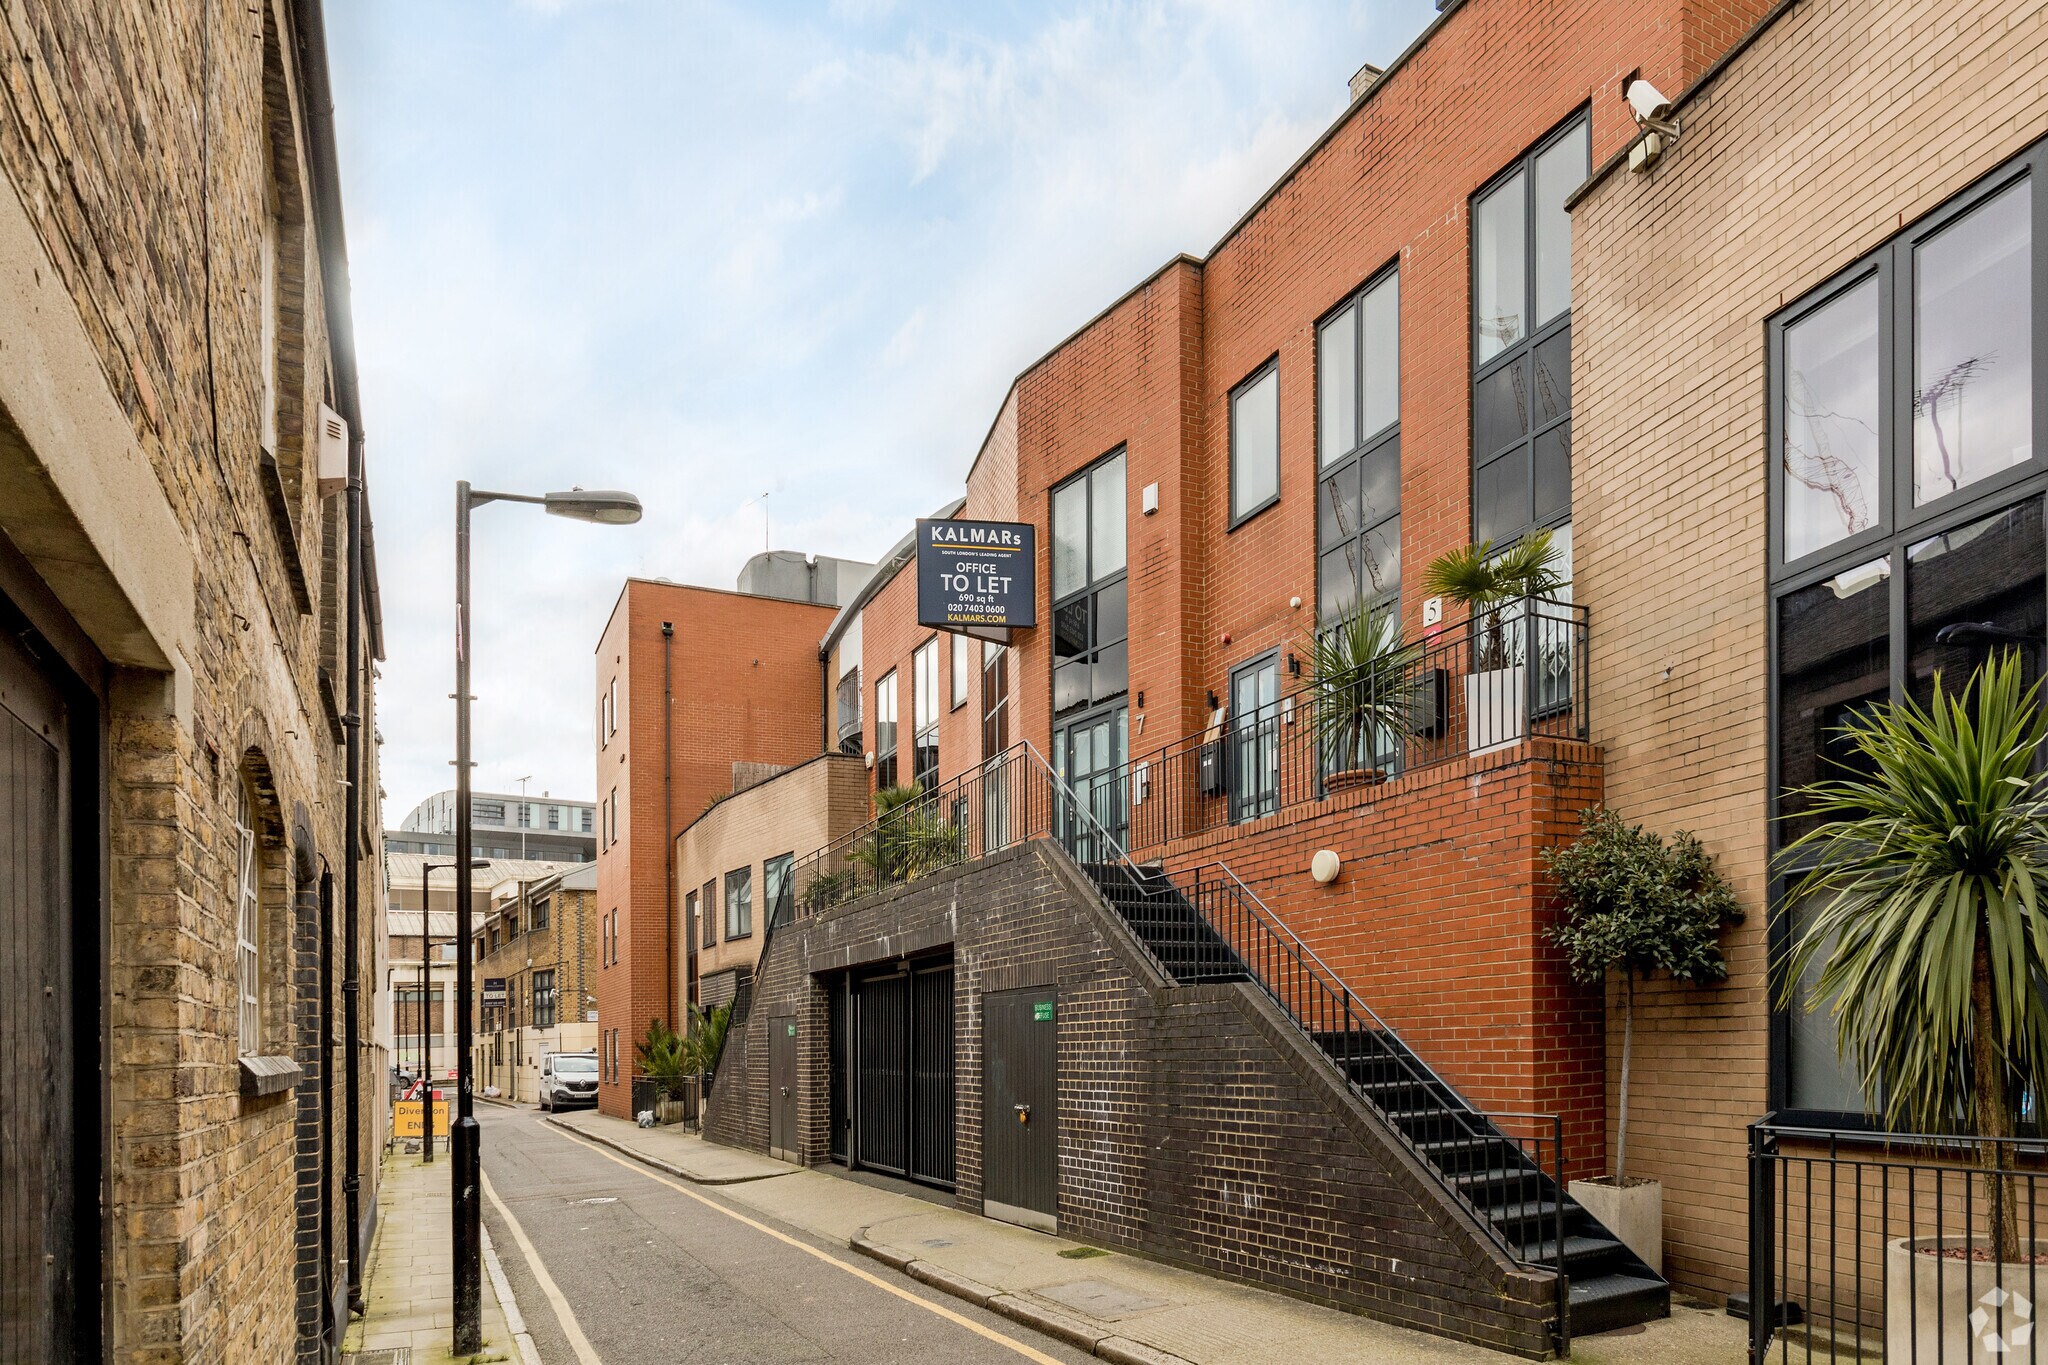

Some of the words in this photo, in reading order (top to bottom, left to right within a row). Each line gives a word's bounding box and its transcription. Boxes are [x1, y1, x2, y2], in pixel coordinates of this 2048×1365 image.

[956, 562, 997, 574] OFFICE
[940, 573, 969, 592] TO
[977, 575, 1012, 594] LET
[958, 593, 974, 602] 690
[976, 596, 986, 604] sq
[988, 594, 995, 603] ft
[947, 603, 963, 612] 020
[964, 604, 984, 613] 7403
[985, 605, 1005, 614] 0600
[1428, 600, 1437, 621] 5
[947, 613, 1007, 623] KALMARS.COM
[1135, 713, 1145, 735] 7
[398, 1107, 445, 1115] Diveron
